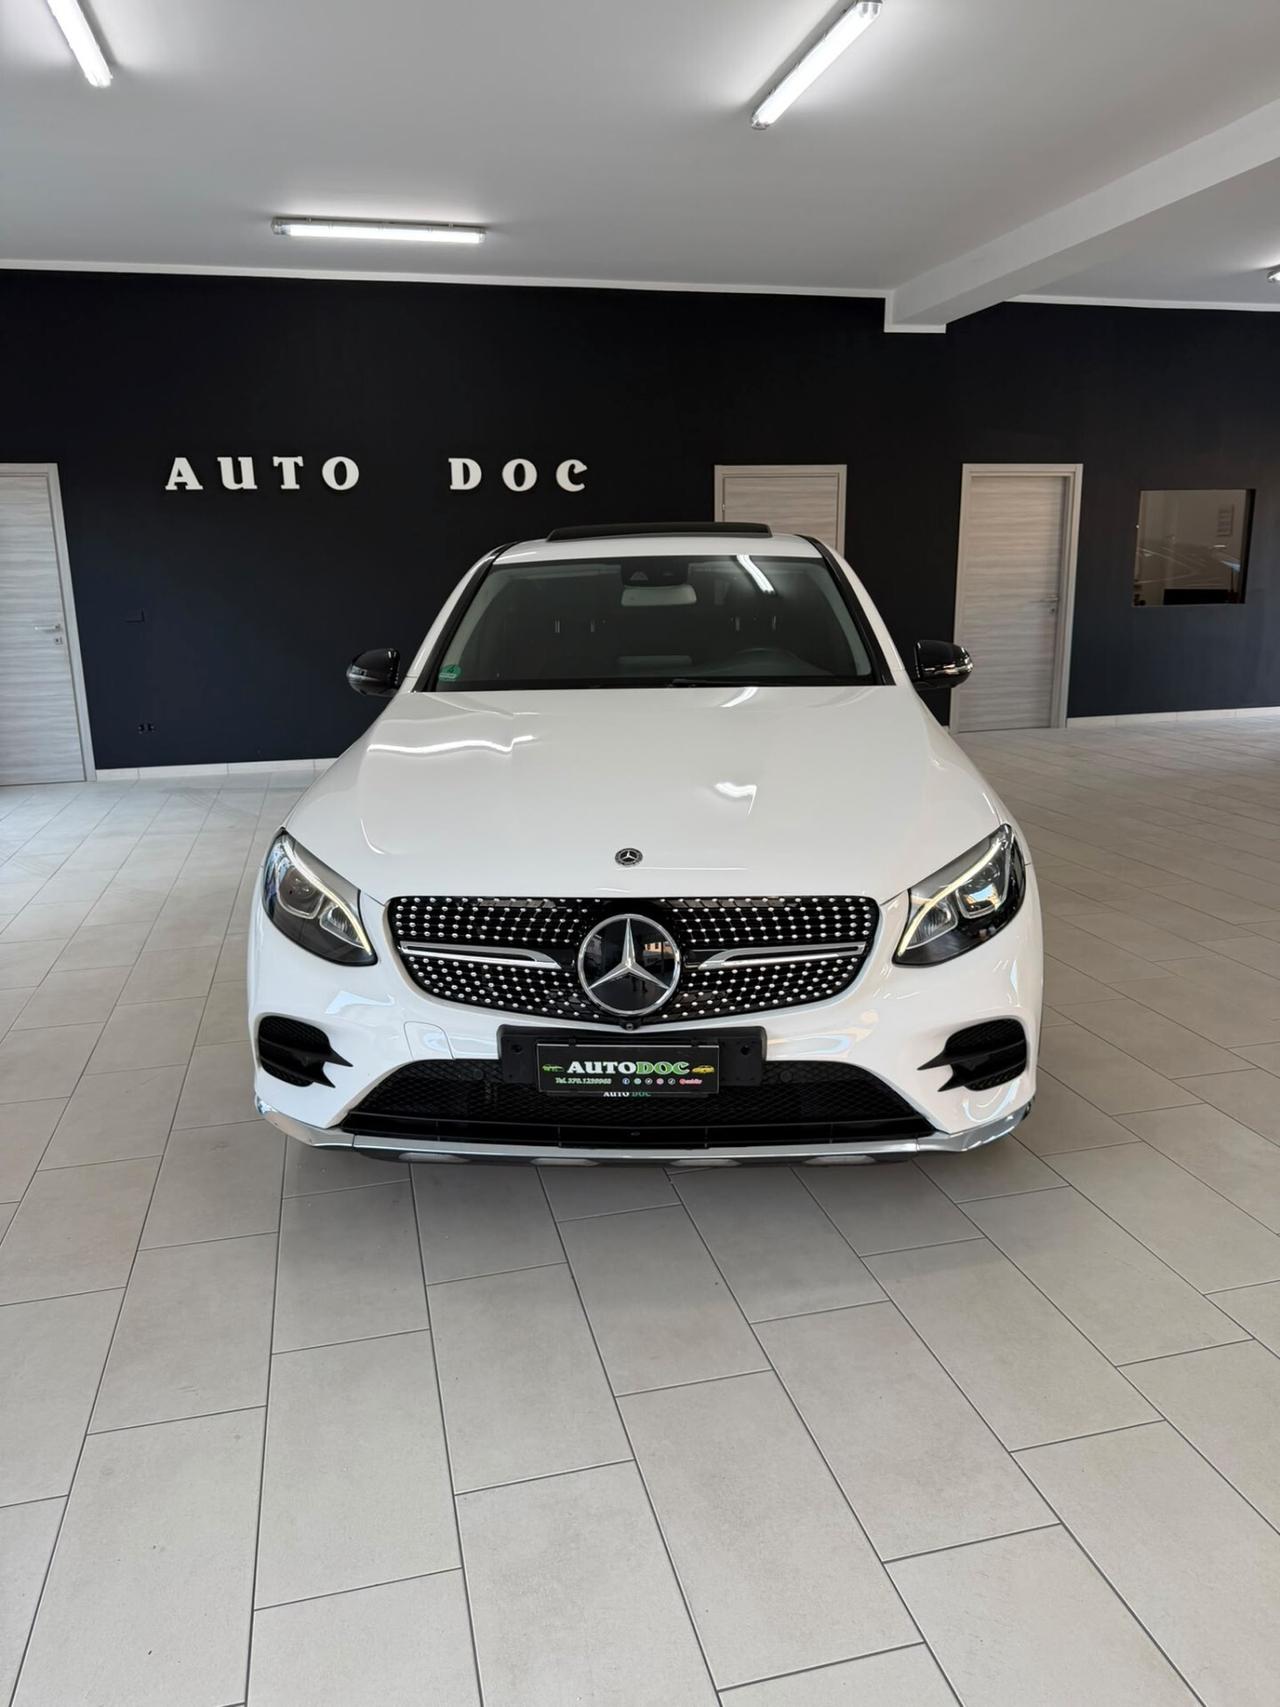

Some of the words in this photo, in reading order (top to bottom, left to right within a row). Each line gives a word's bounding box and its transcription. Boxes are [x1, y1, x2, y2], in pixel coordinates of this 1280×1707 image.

[165, 456, 360, 491] AUTO
[448, 457, 589, 492] DOC
[567, 1061, 690, 1075] AUTODOC
